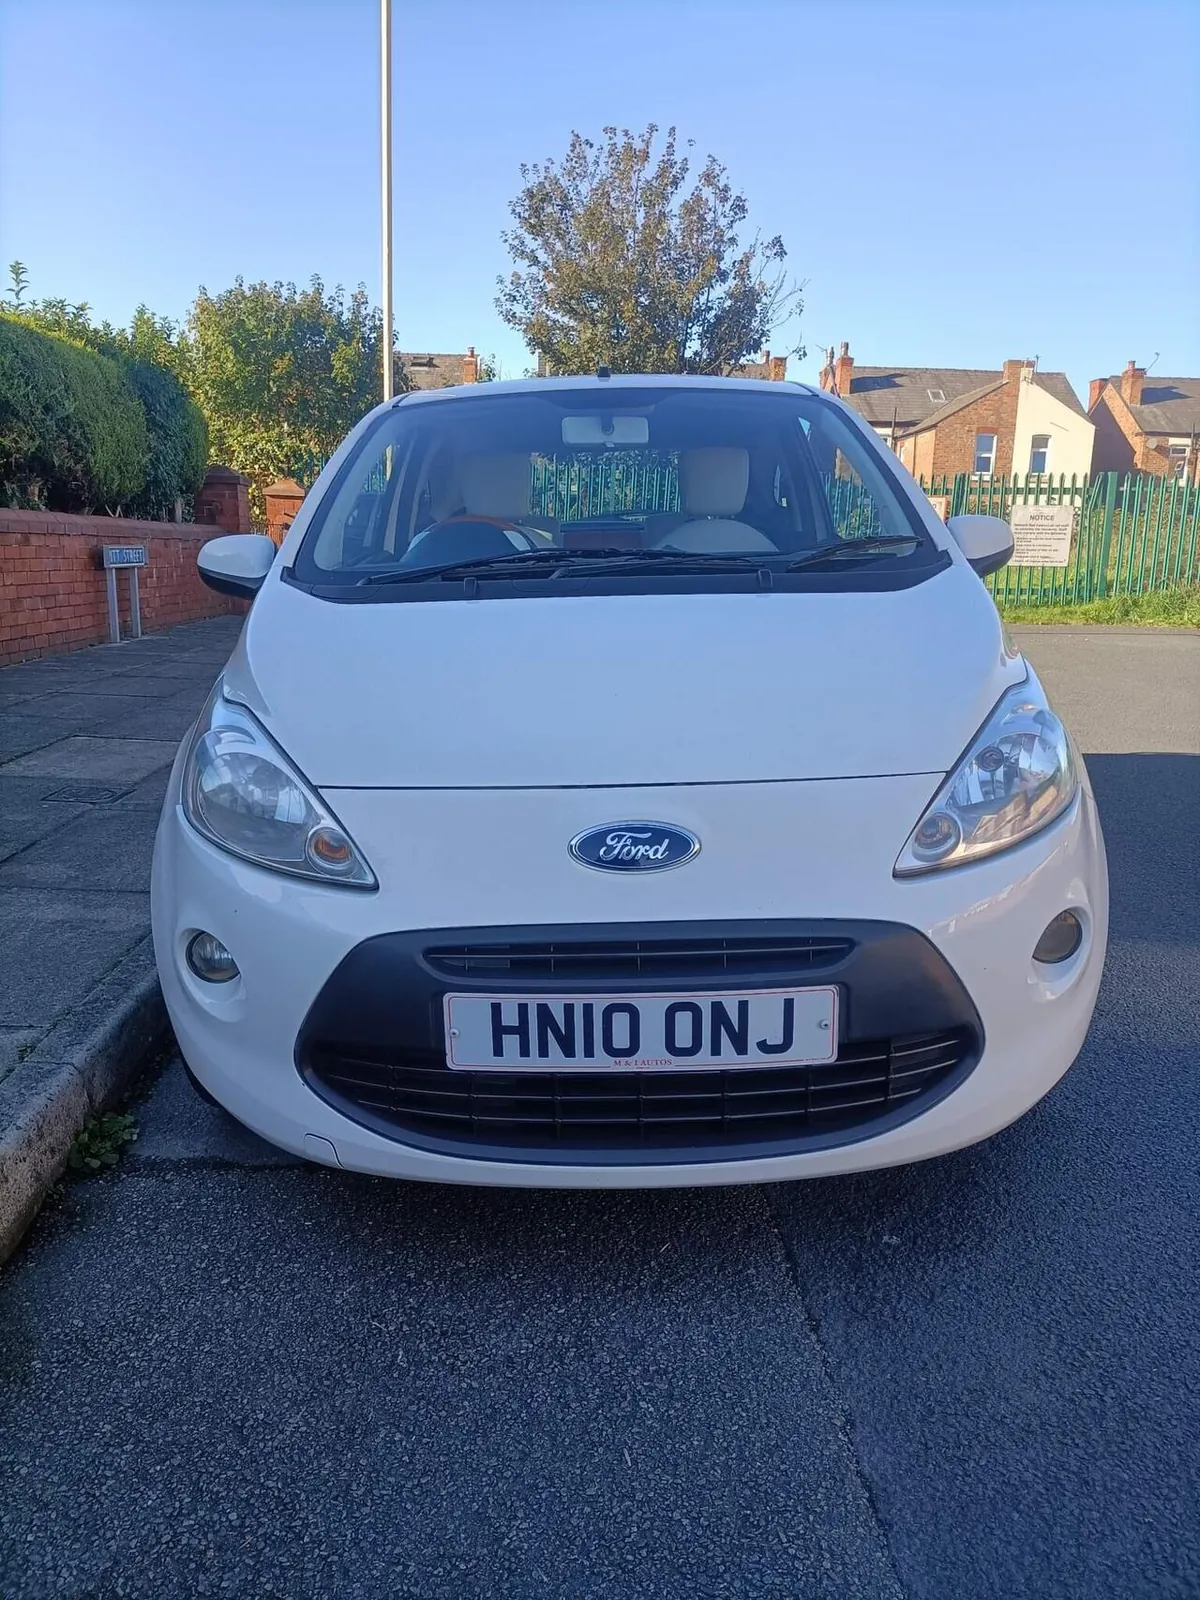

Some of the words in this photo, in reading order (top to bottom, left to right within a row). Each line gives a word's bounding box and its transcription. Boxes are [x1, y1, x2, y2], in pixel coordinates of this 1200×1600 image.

[123, 549, 143, 562] STREET
[600, 832, 670, 861] Ford
[490, 1001, 641, 1058] HN10
[664, 997, 795, 1058] ONJ
